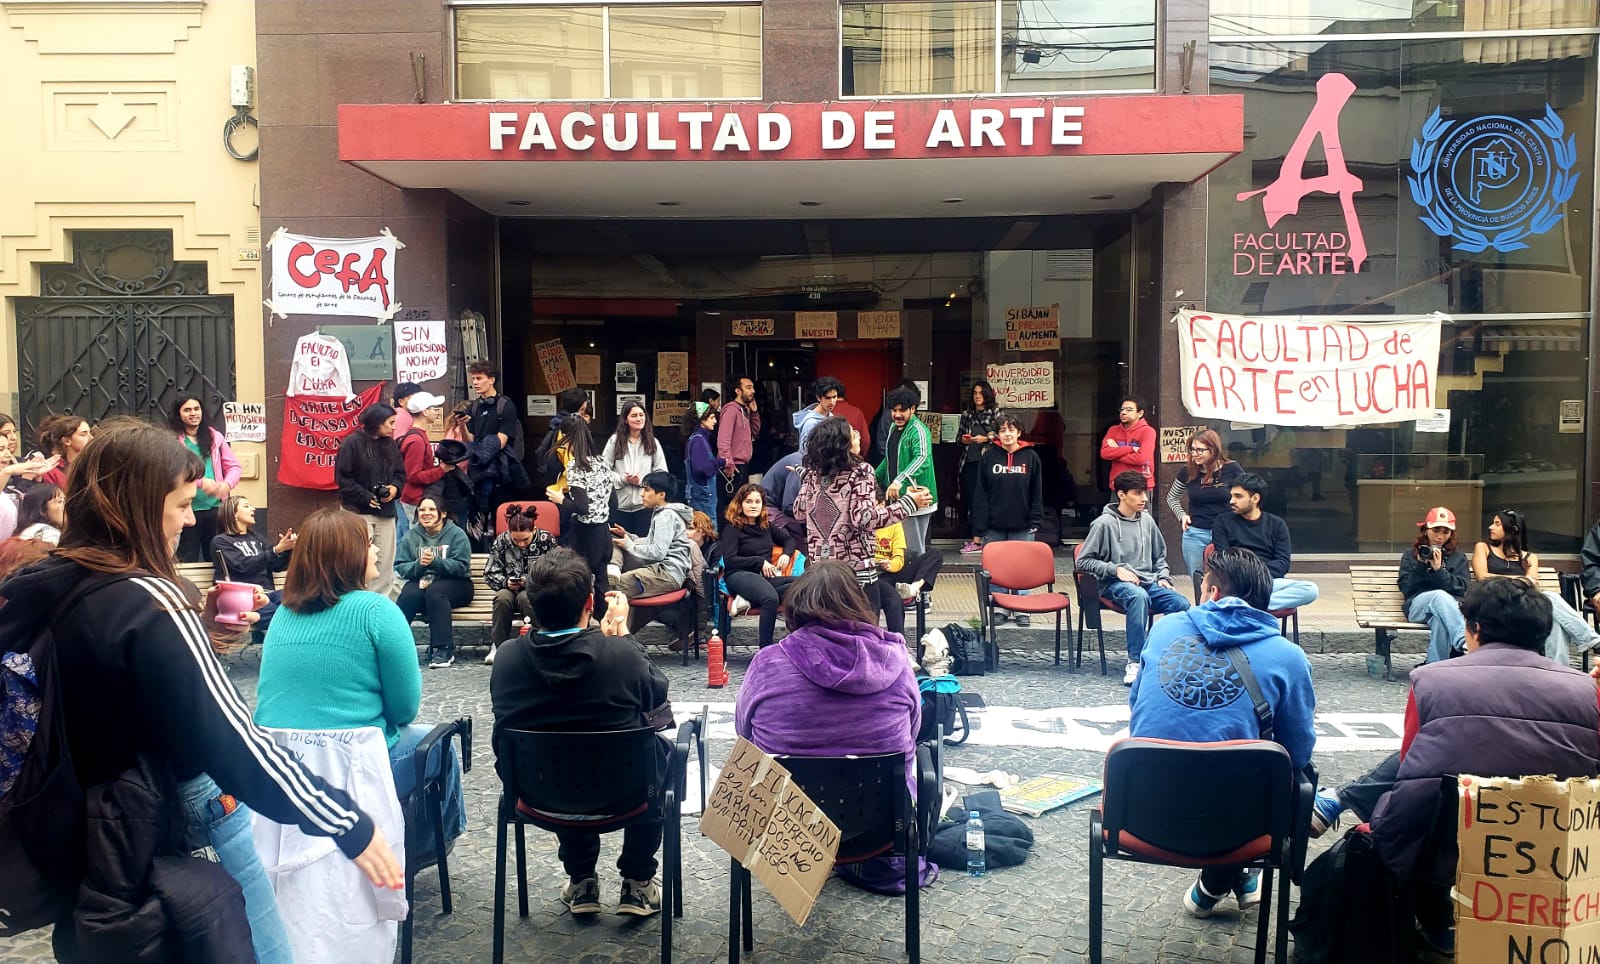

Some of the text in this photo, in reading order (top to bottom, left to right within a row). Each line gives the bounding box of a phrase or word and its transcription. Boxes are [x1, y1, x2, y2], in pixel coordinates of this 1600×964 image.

[489, 106, 1085, 151] FACULTAD DE ARTE
[1442, 122, 1544, 168] UNIVERSIDAD NACIONAL DEL CENTRO
[1456, 204, 1489, 224] PROVINCIA
[1233, 232, 1346, 250] FACULTAD
[1007, 308, 1050, 320] SI BAJAN
[801, 328, 834, 338] NUESTRO
[1006, 321, 1017, 332] EL
[401, 326, 430, 342] SIN
[1018, 330, 1058, 341] AUMENTA
[1188, 315, 1413, 363] FACULTAD de
[398, 343, 448, 356] UNIVERSIDAD
[1008, 340, 1020, 350] LA
[406, 356, 440, 367] NO HAY
[399, 369, 437, 382] FUTURO
[986, 367, 1051, 378] UNIVERSIDAD
[1192, 360, 1430, 416] ARTE en LUCHA
[1007, 390, 1049, 403] SIEMPRE
[224, 403, 262, 415] SI HAY
[300, 401, 339, 414] ARTE
[240, 423, 259, 431] HAY
[1162, 438, 1186, 446] LUCHA
[992, 464, 1027, 474] Orsai
[289, 732, 328, 748] DIGNO
[732, 751, 761, 778] LA
[716, 782, 750, 818] PARA
[712, 800, 729, 817] UN
[749, 789, 768, 808] un
[774, 806, 824, 863] DERECHO
[1484, 834, 1590, 882] ES UN
